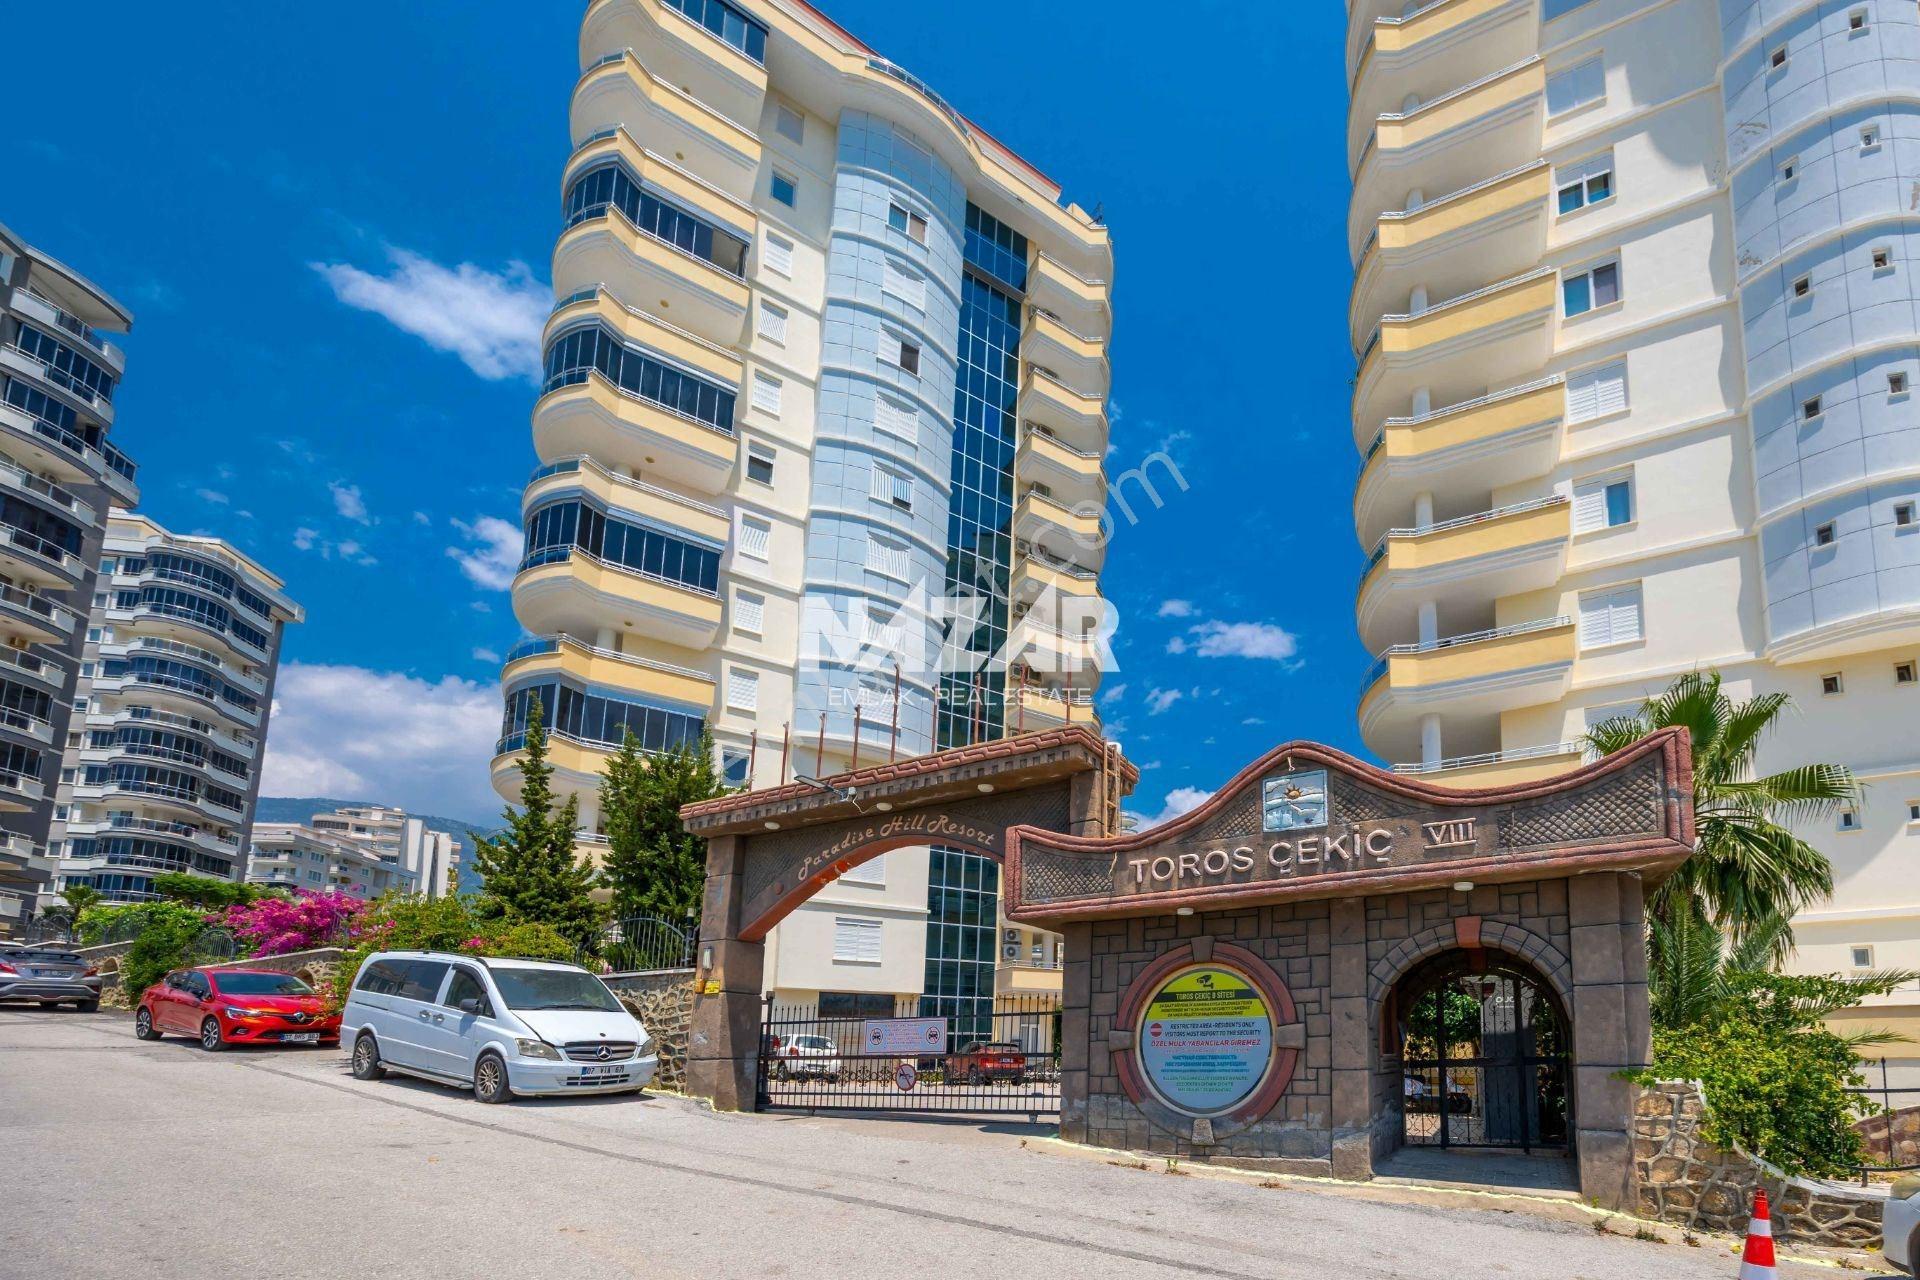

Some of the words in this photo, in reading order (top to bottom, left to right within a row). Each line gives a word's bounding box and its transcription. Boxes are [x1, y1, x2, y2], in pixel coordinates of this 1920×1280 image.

[797, 826, 875, 882] Paradise
[880, 815, 927, 838] Hill
[926, 813, 996, 847] Resort
[1129, 845, 1255, 884] TOROS
[1268, 823, 1394, 874] ÇEKİÇ
[1422, 817, 1478, 850] VIII
